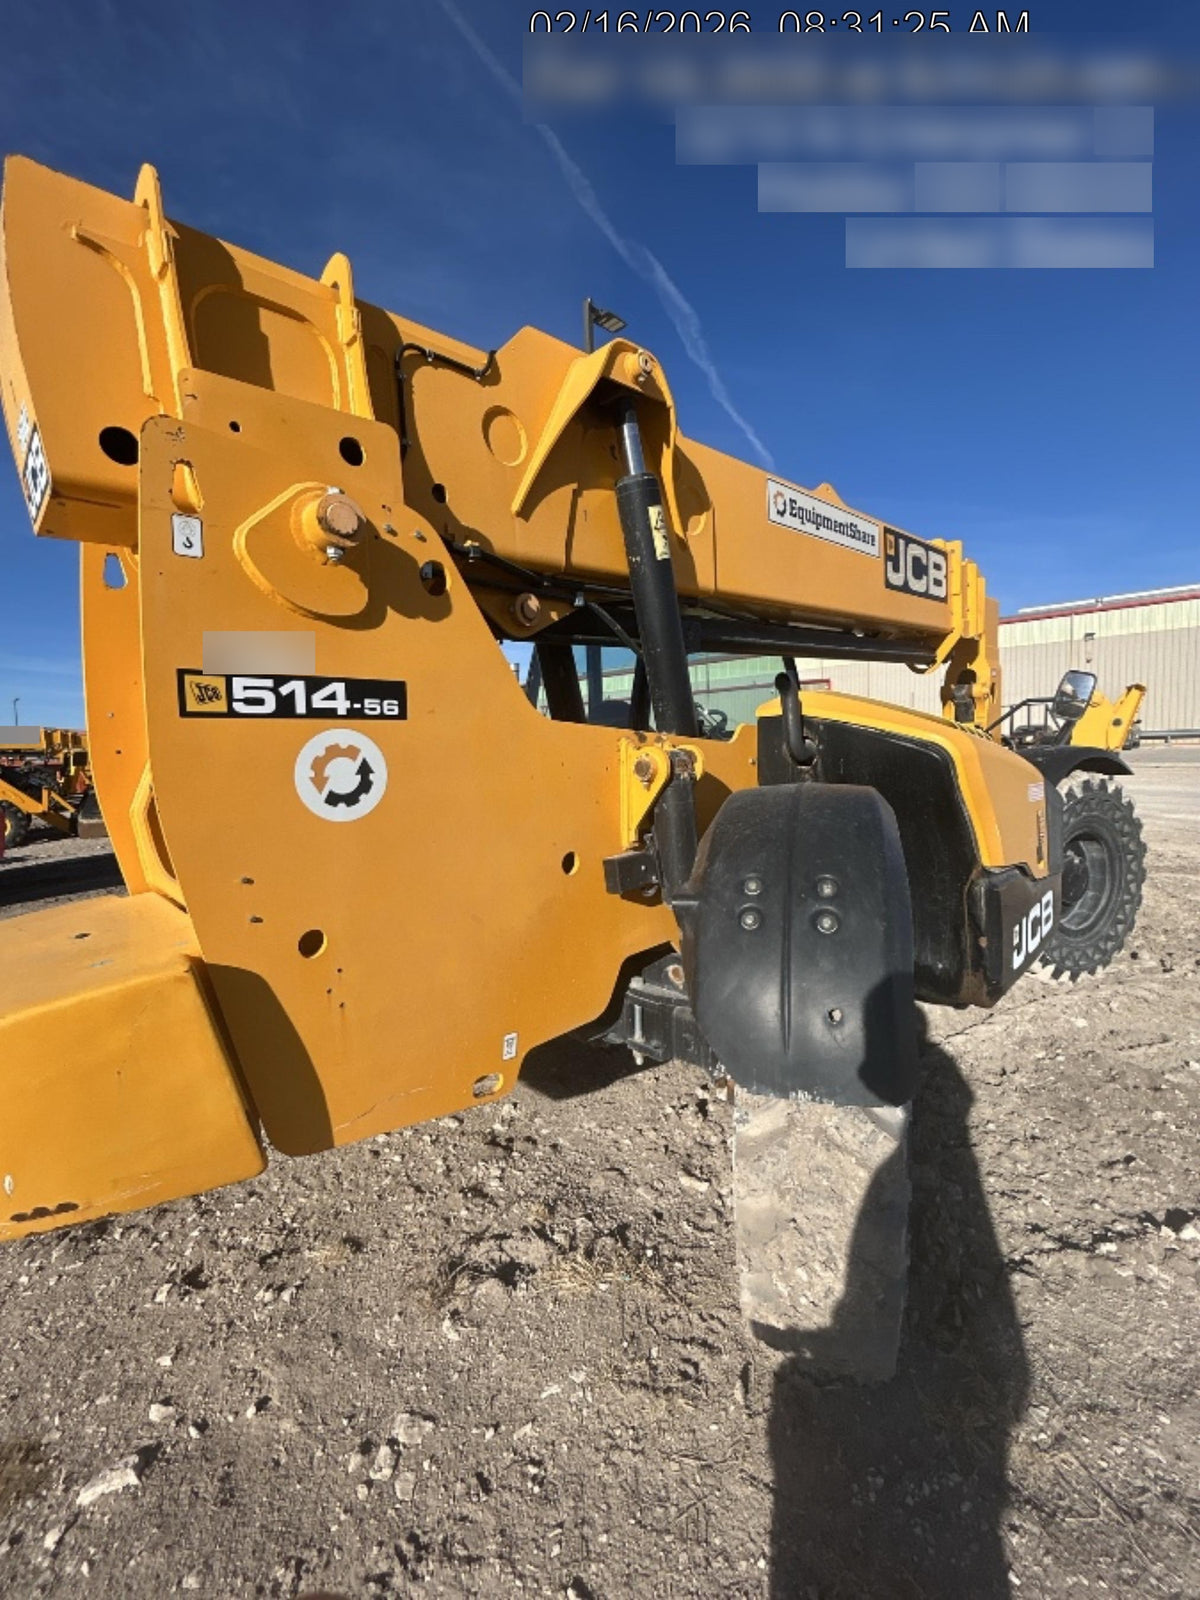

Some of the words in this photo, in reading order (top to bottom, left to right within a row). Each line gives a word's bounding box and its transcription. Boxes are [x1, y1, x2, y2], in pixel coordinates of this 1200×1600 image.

[788, 497, 876, 547] EquipmentShare
[887, 538, 947, 598] JCB
[231, 676, 399, 715] 514-56
[1013, 889, 1054, 971] JCB
